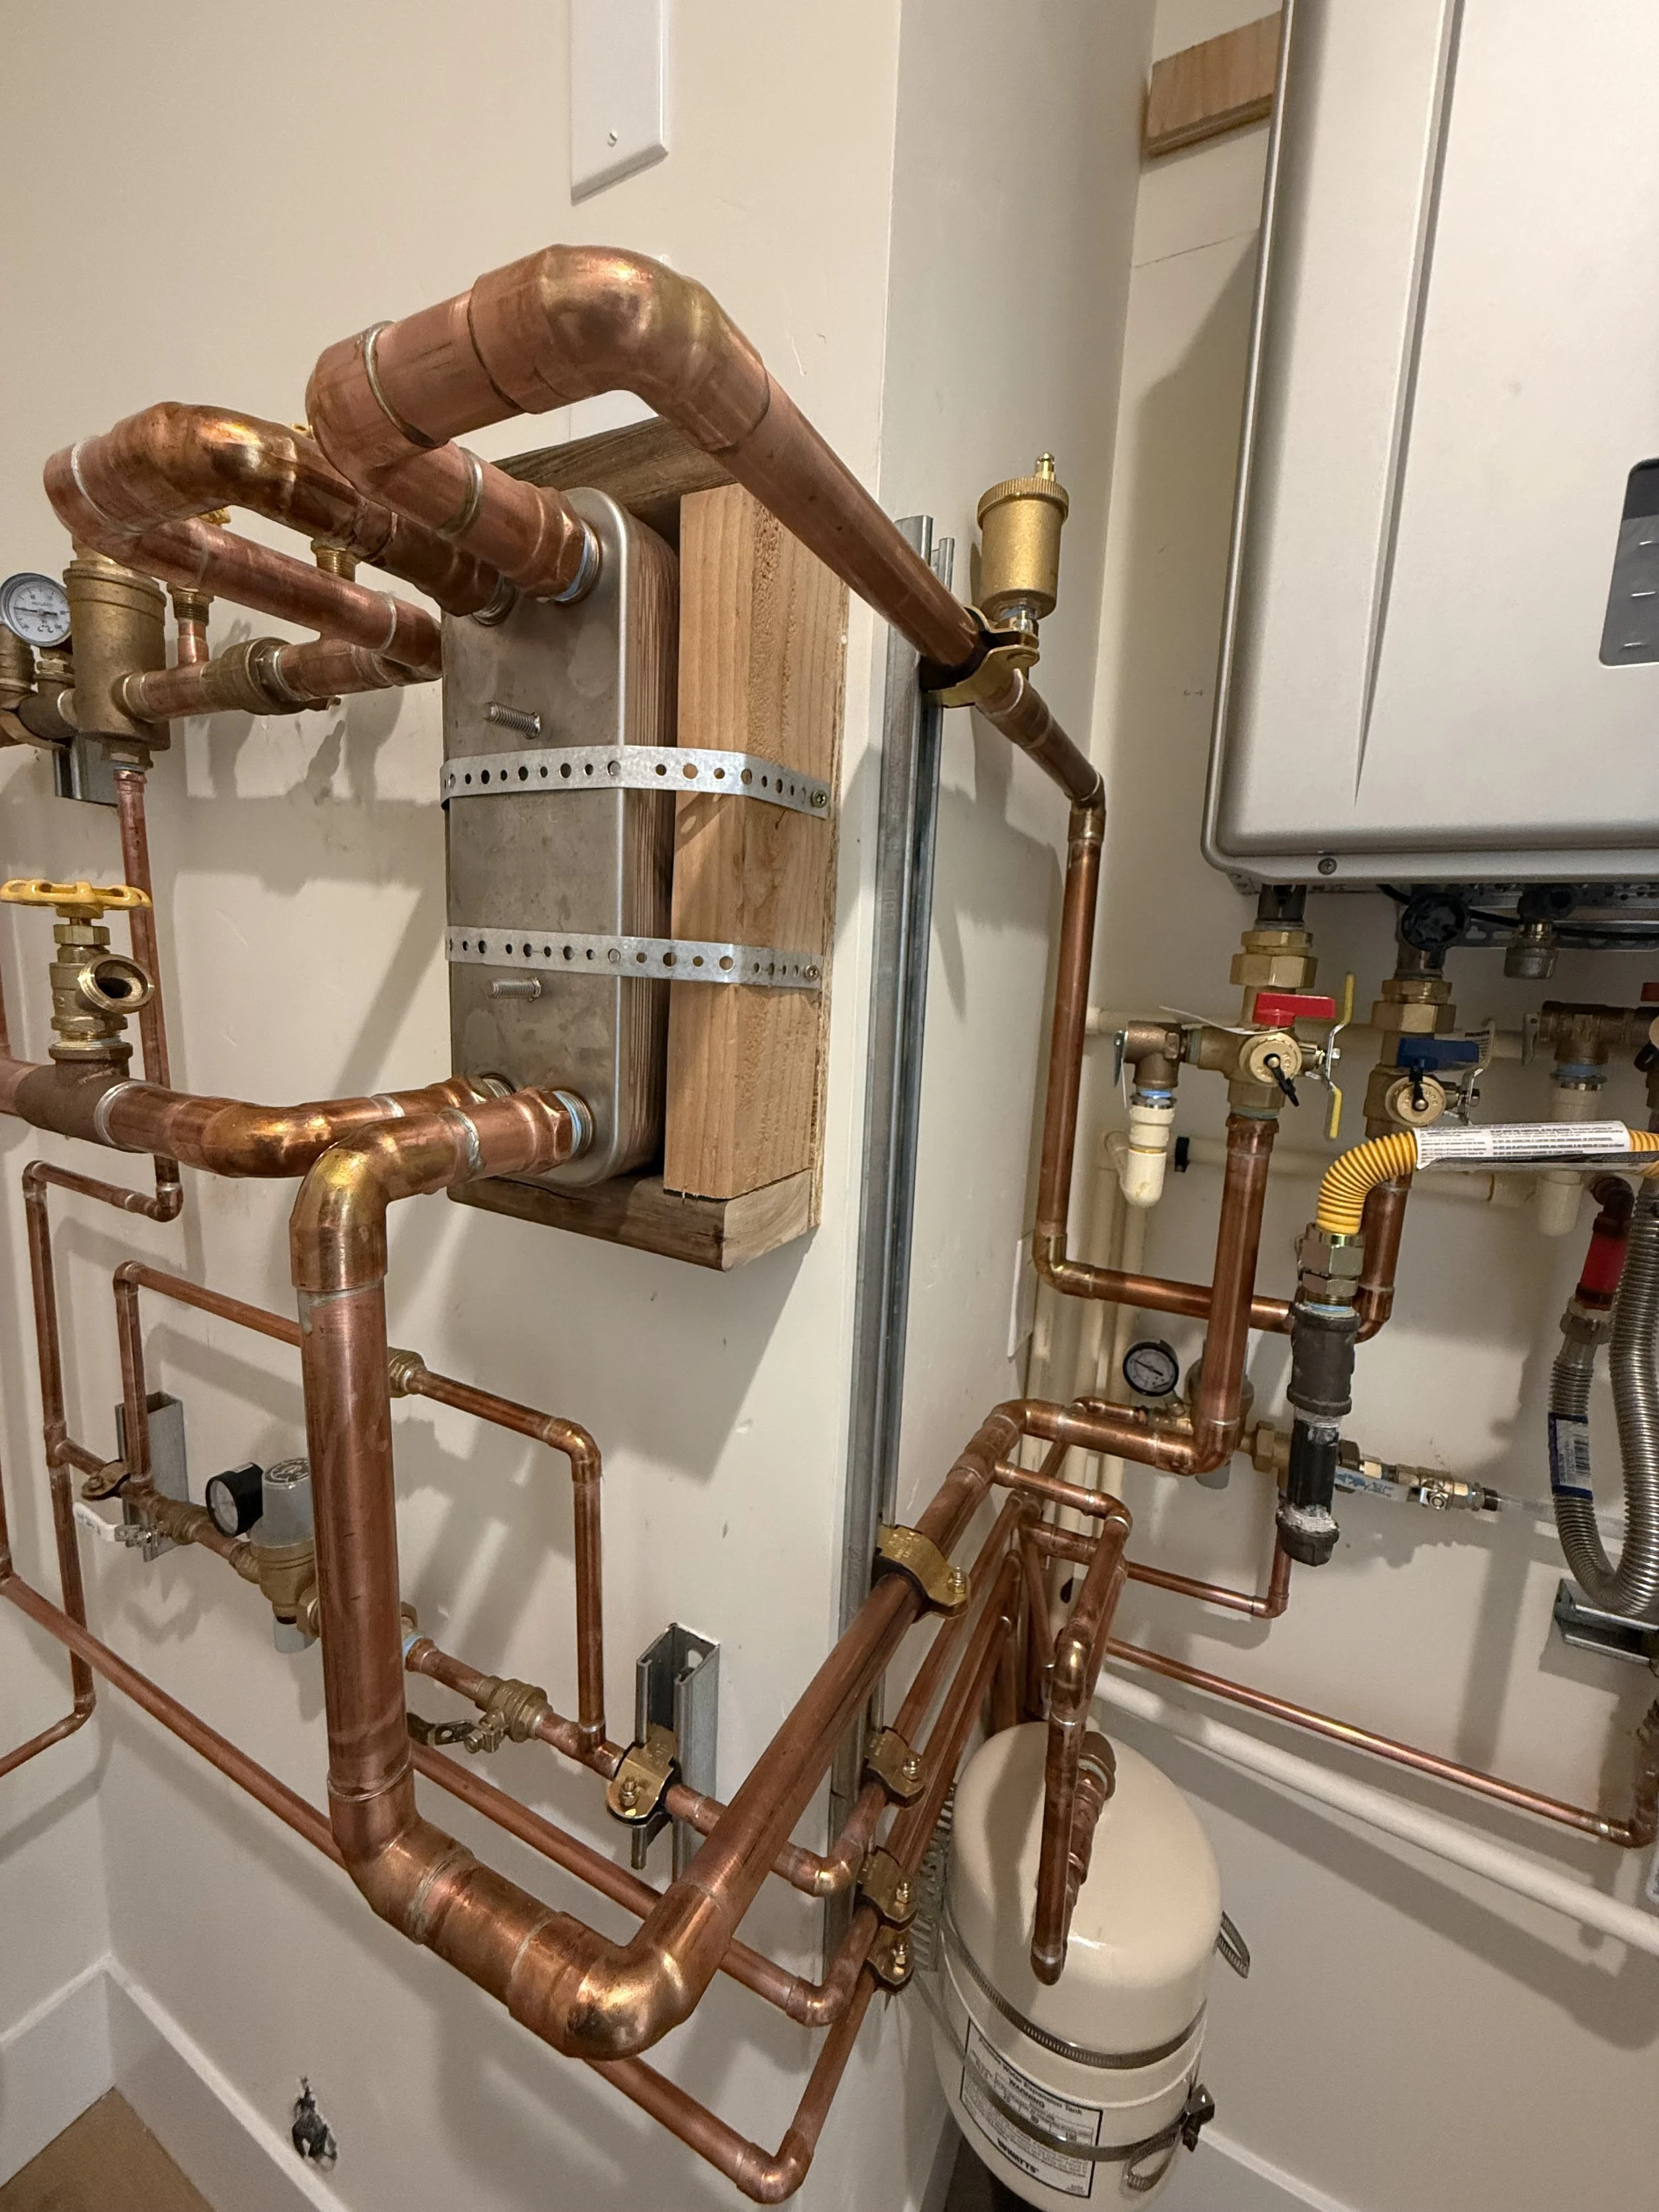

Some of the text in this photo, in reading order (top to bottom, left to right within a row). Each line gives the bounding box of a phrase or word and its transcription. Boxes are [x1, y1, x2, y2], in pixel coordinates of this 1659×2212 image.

[1008, 2077, 1046, 2109] WARNING
[1064, 2103, 1083, 2116] Tank
[997, 2137, 1037, 2174] WATTS
